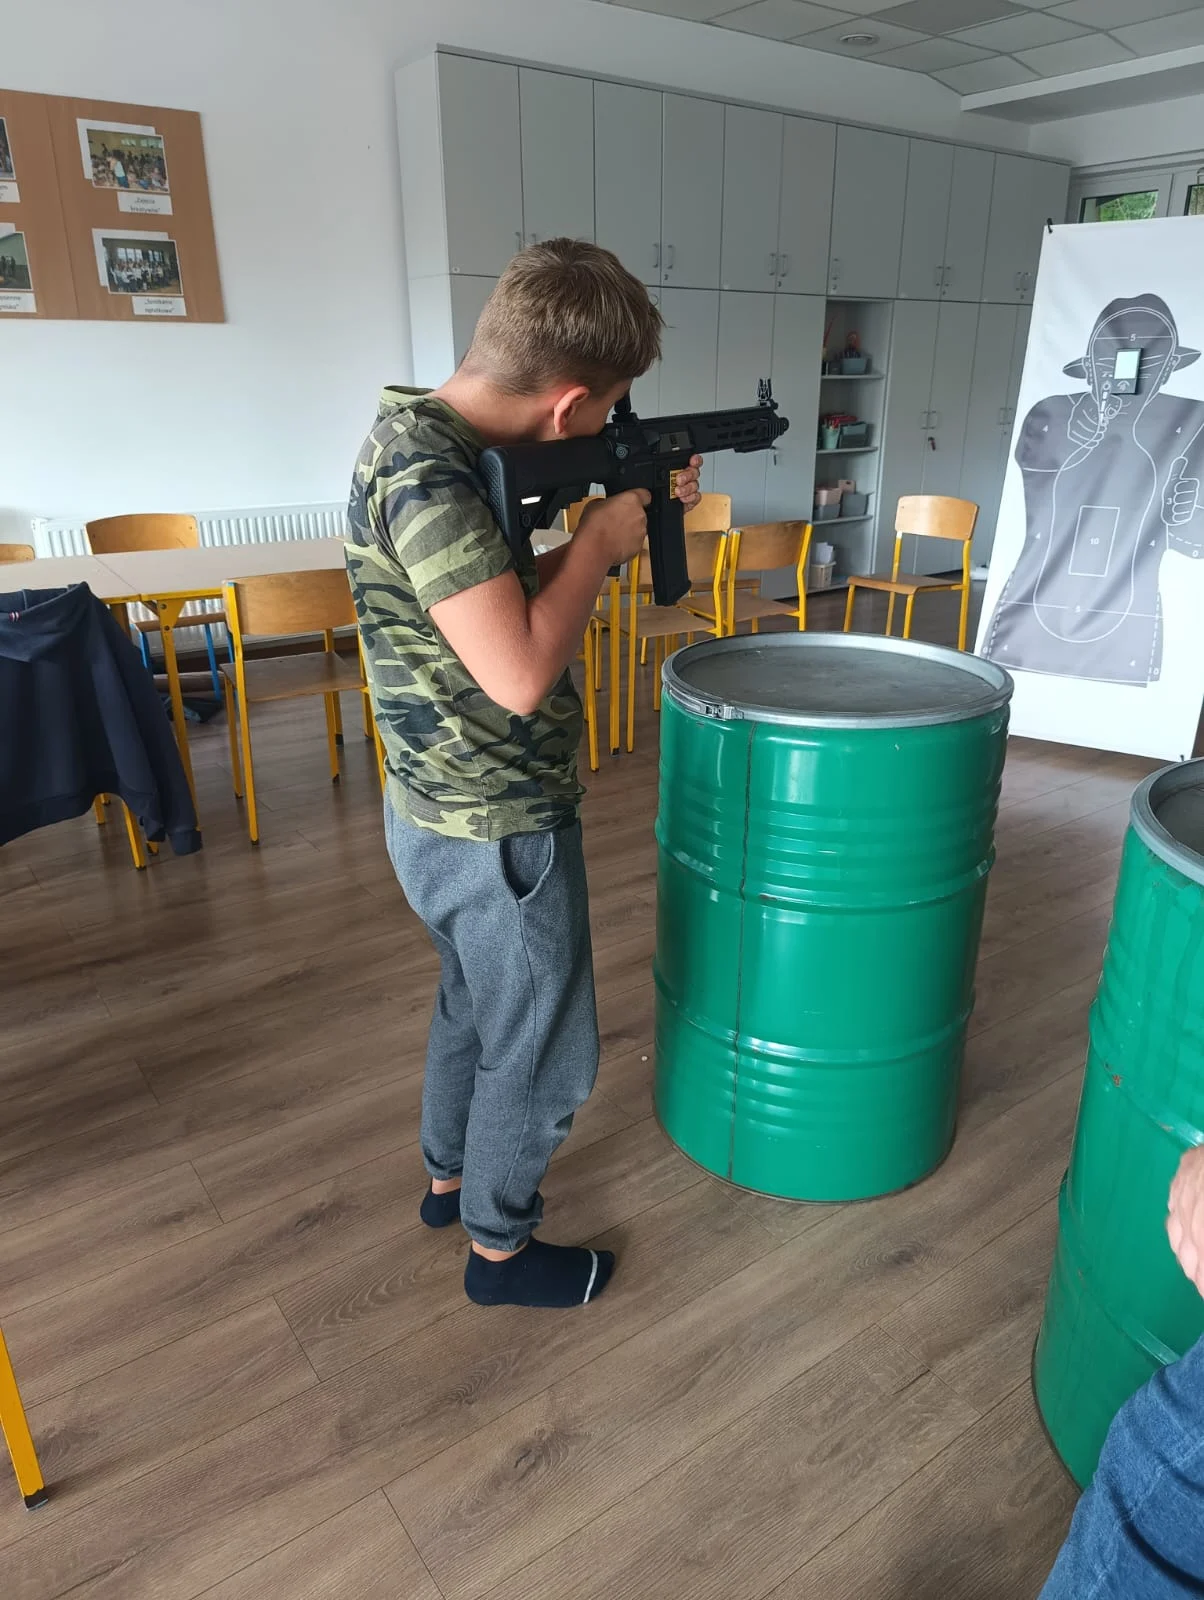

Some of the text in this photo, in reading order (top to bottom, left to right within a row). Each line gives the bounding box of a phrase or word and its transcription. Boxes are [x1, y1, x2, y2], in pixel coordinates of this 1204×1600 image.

[1129, 333, 1137, 342] 5
[1166, 497, 1172, 505] 3
[1090, 537, 1100, 545] 10
